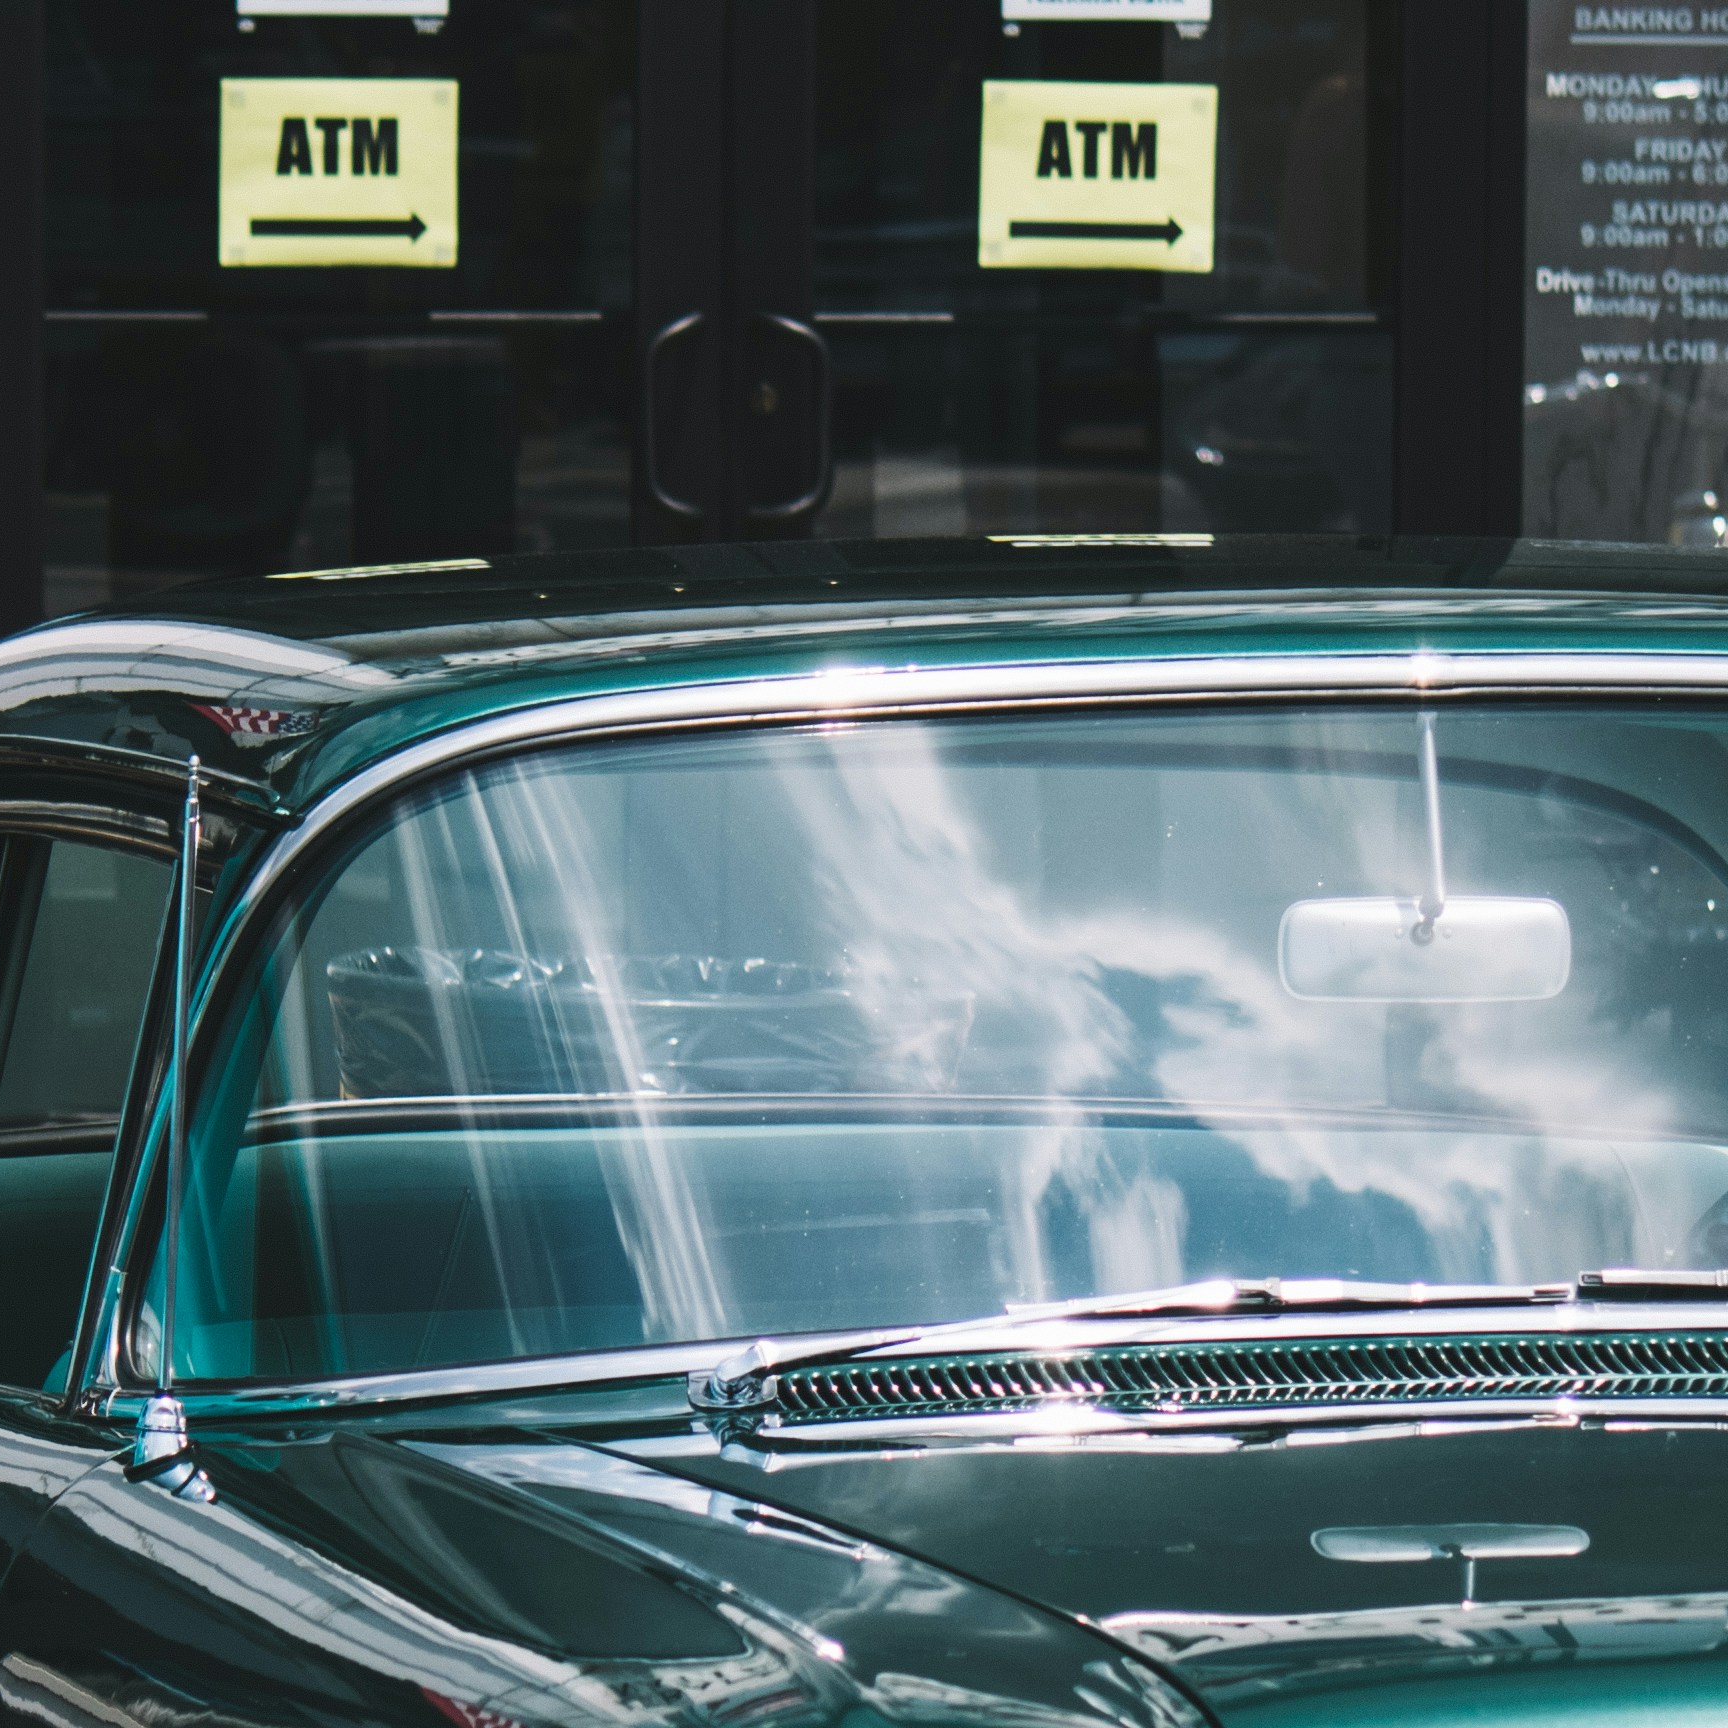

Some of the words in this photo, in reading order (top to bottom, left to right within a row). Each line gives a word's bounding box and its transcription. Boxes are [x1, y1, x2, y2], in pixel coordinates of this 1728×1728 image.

[1575, 8, 1693, 32] BANKING
[1583, 101, 1670, 124] 9:00am
[276, 117, 398, 176] ATM
[1036, 120, 1157, 180] ATM
[1634, 137, 1727, 161] FRIDAY
[1581, 160, 1670, 184] 9:00am
[1580, 222, 1669, 248] 9:00am
[1574, 294, 1661, 323] Monday
